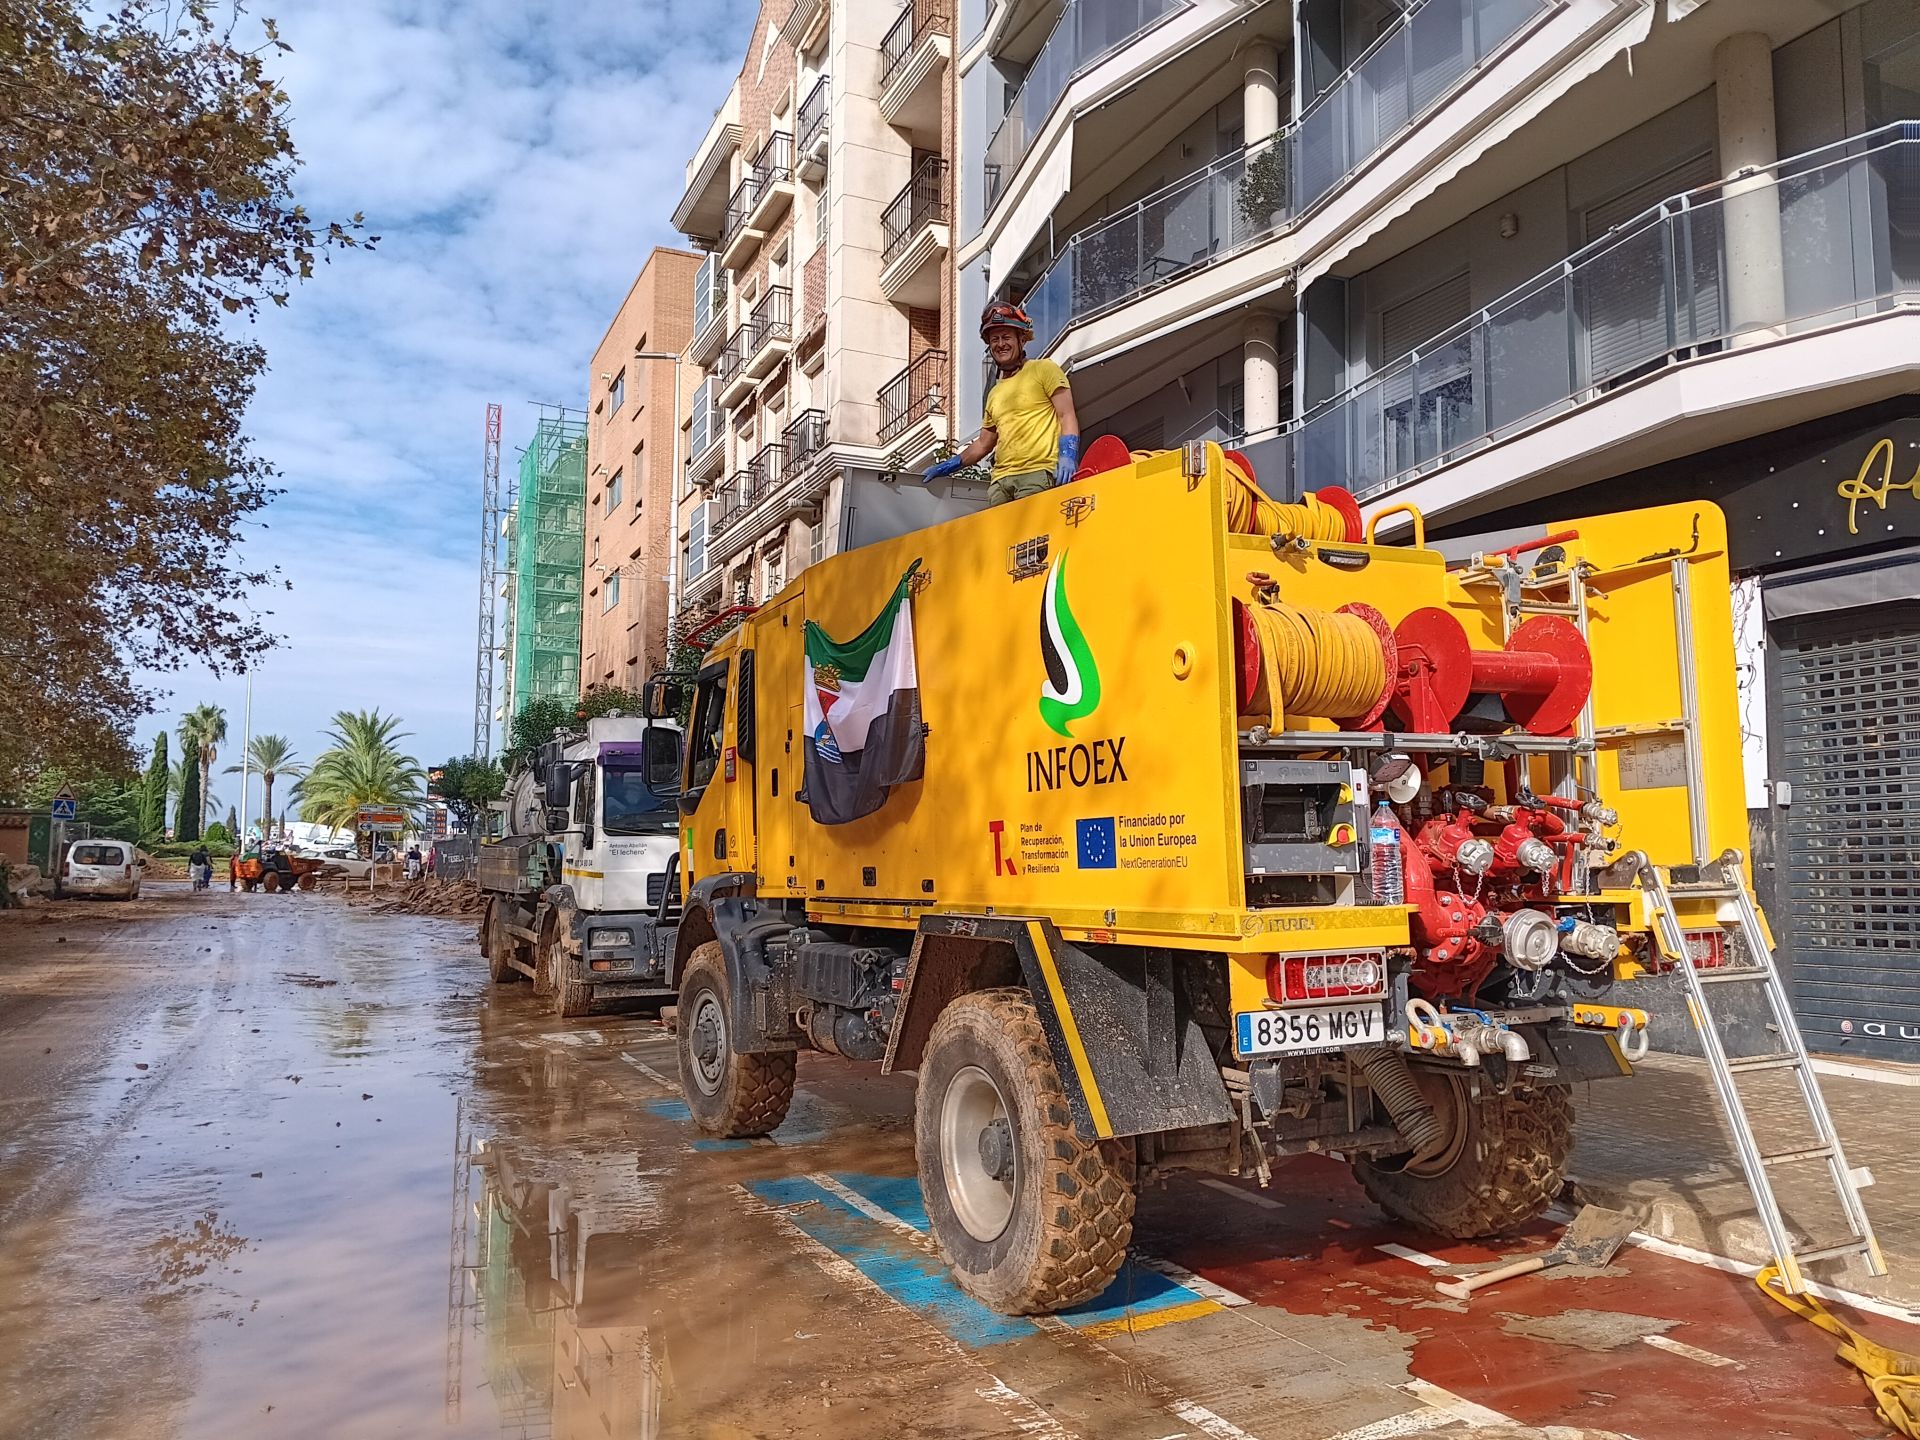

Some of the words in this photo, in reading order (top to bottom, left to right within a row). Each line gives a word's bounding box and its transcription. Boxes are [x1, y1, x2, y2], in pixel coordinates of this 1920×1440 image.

[1837, 438, 1920, 534] A
[1026, 736, 1128, 793] INFOEX
[1020, 823, 1033, 833] Plan
[1034, 821, 1043, 832] de
[1118, 812, 1167, 828] Financiado
[1169, 814, 1185, 828] por
[1020, 834, 1065, 848] Recuperación,
[1119, 835, 1127, 848] la
[1129, 834, 1155, 848] Union
[1157, 833, 1197, 849] Europea
[1021, 848, 1069, 860] Transformación
[1022, 866, 1027, 875] y
[1027, 863, 1061, 873] Resiliencia
[1120, 855, 1189, 869] NextGenerationEU
[1257, 1014, 1320, 1046] 8356
[1328, 1009, 1373, 1040] MGV
[1286, 1046, 1341, 1056] www.iturri.com
